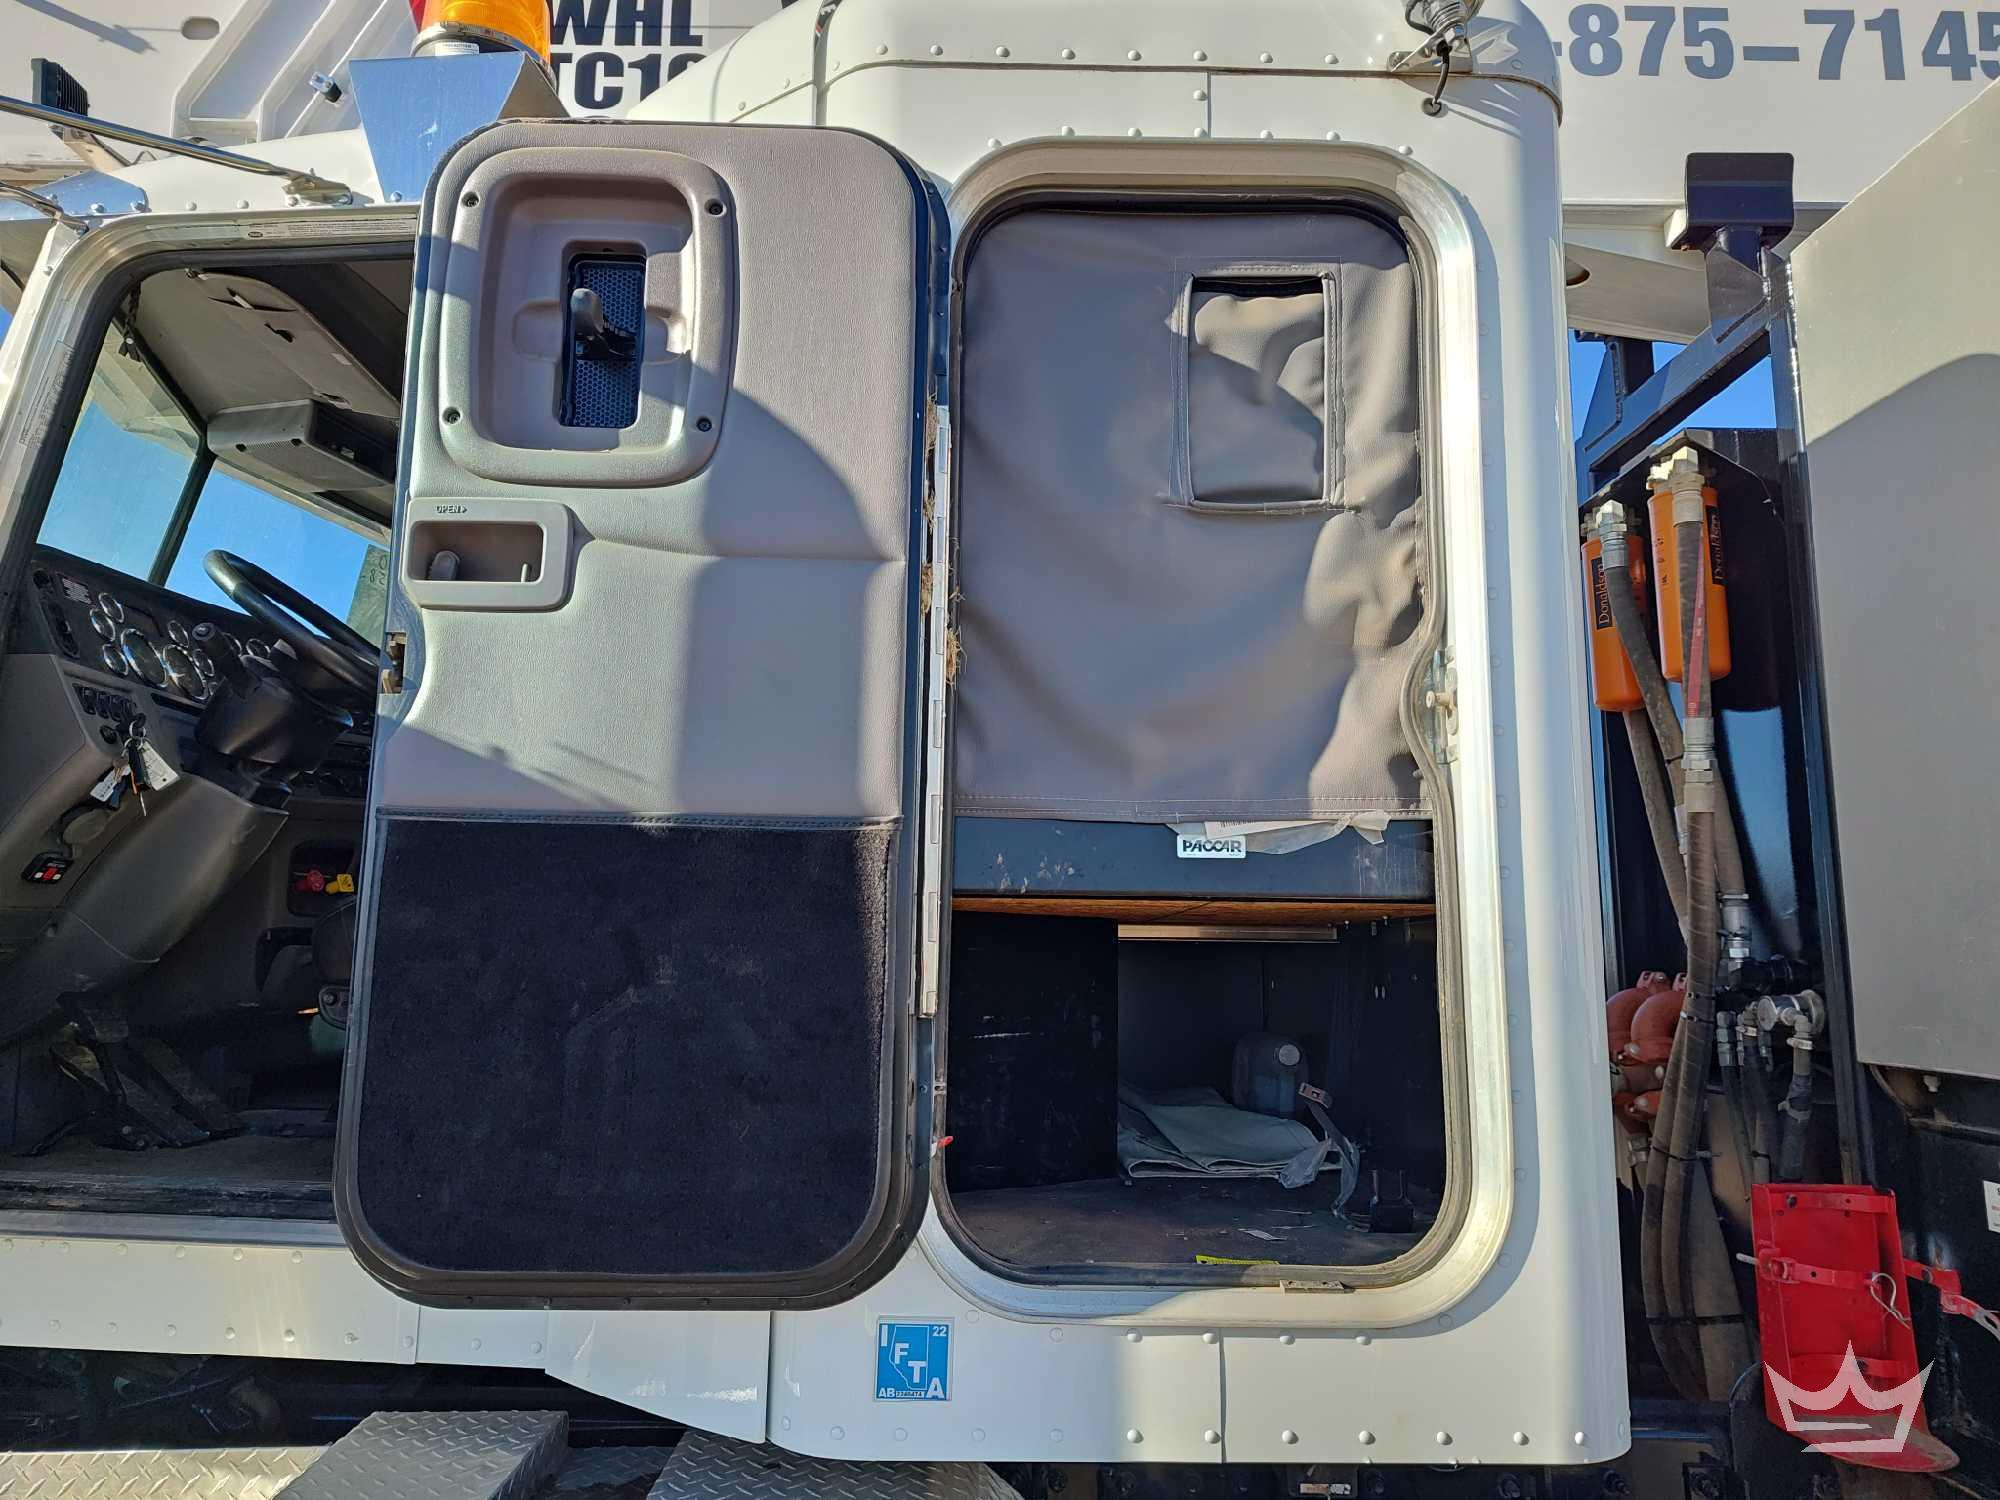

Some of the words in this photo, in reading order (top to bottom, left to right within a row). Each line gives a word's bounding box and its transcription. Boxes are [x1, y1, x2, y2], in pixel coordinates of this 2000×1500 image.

[1553, 3, 2000, 81] 875-714
[435, 504, 461, 514] OPEN
[1183, 839, 1242, 853] PACCAR
[932, 1325, 947, 1337] 22
[878, 1387, 896, 1398] AB
